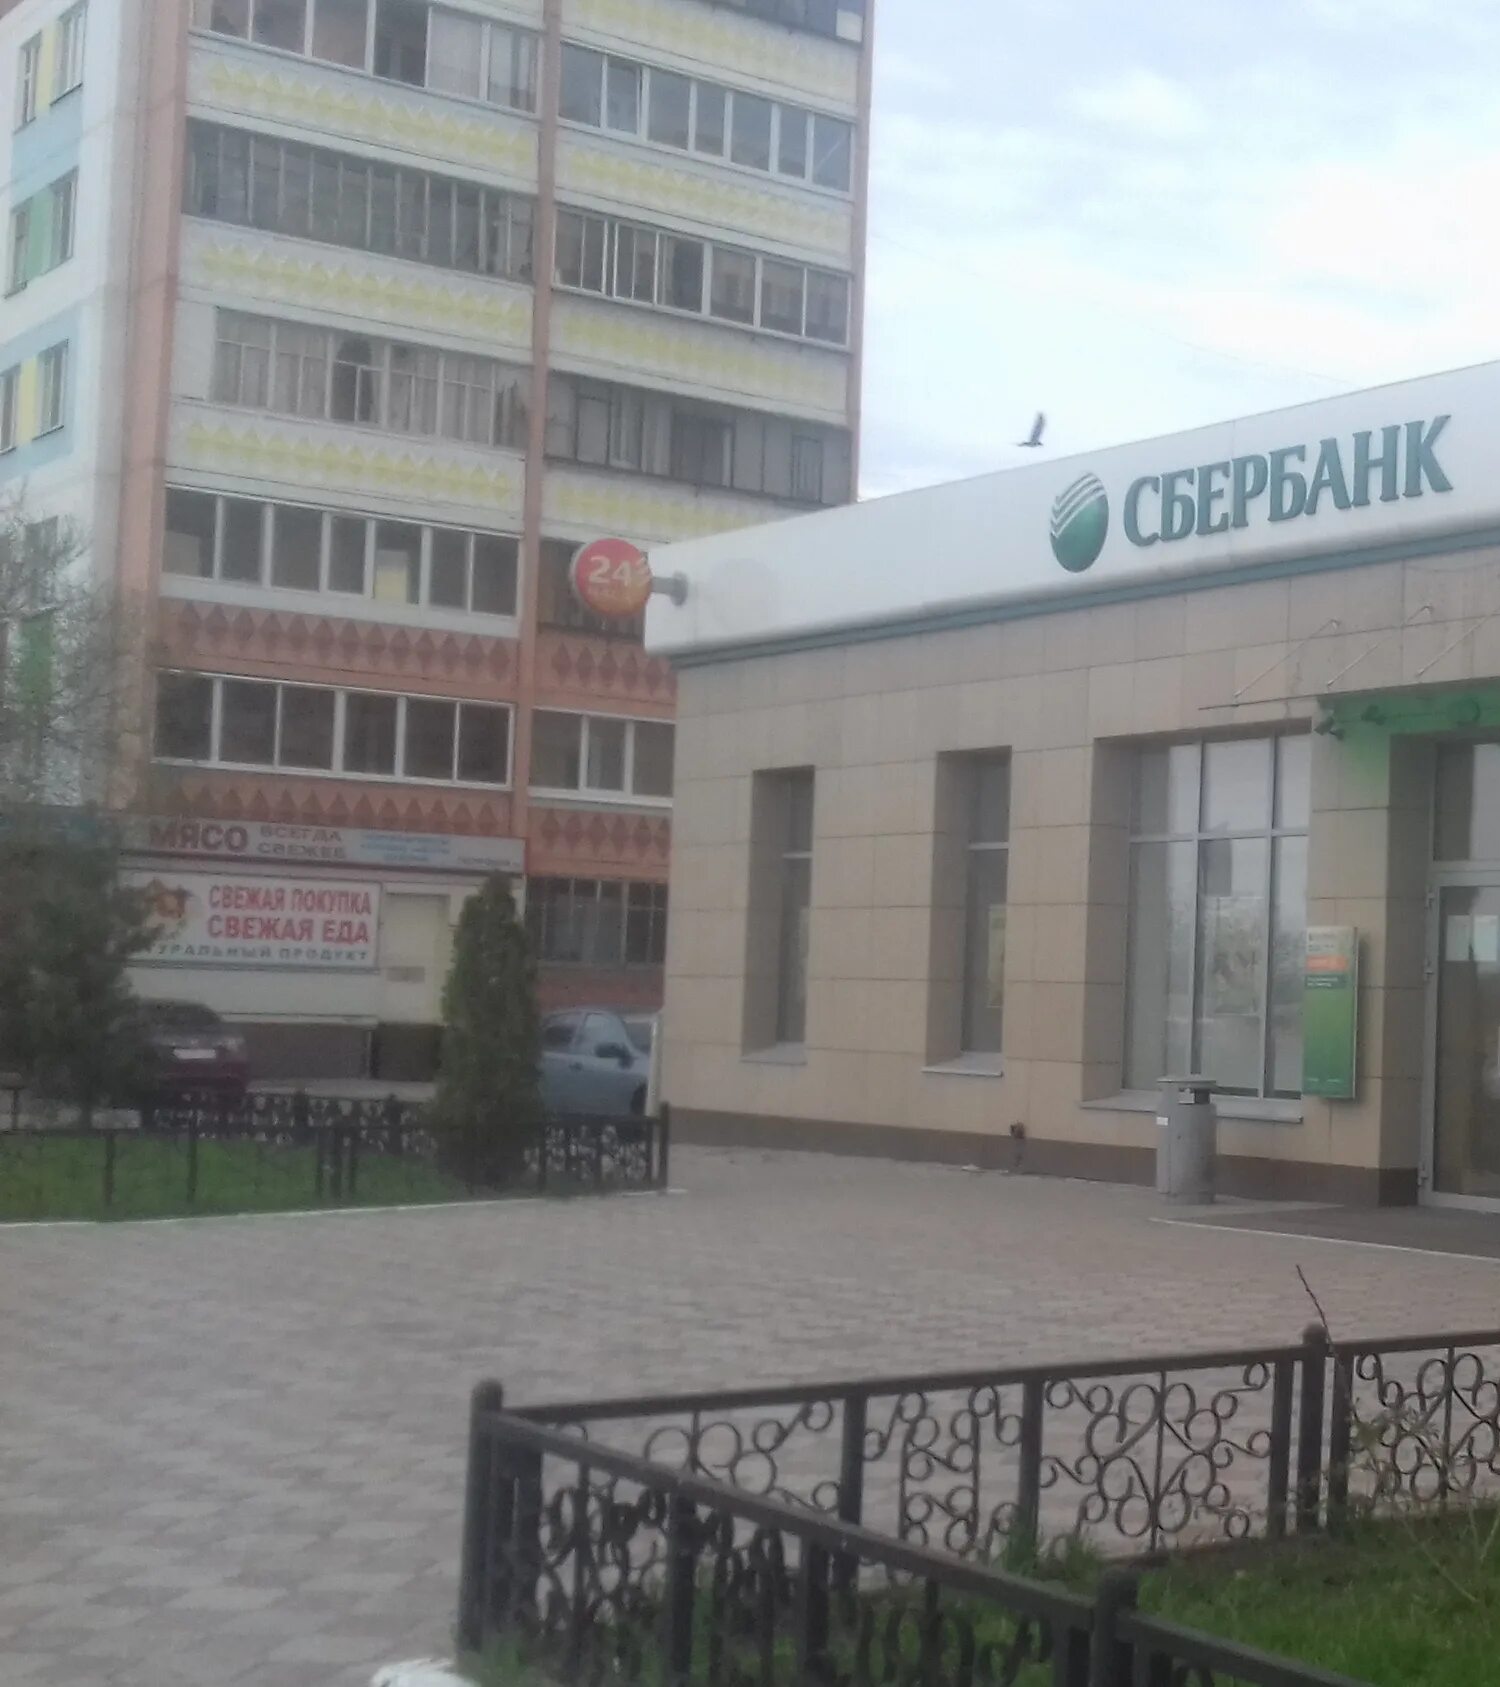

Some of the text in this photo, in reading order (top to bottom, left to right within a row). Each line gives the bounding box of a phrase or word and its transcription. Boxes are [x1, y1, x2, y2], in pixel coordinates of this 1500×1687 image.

[1123, 414, 1453, 548] СБЕРБАНК
[150, 821, 248, 852] МЯСО
[260, 825, 342, 842] ВСЕГДА
[208, 884, 371, 915] СВЕЖАЯ ПОКУПКА
[206, 914, 369, 944] СВЕЖАЯ ЕДА
[157, 943, 368, 961] УРАЛЬНЫЙ ПРОДУКТ
